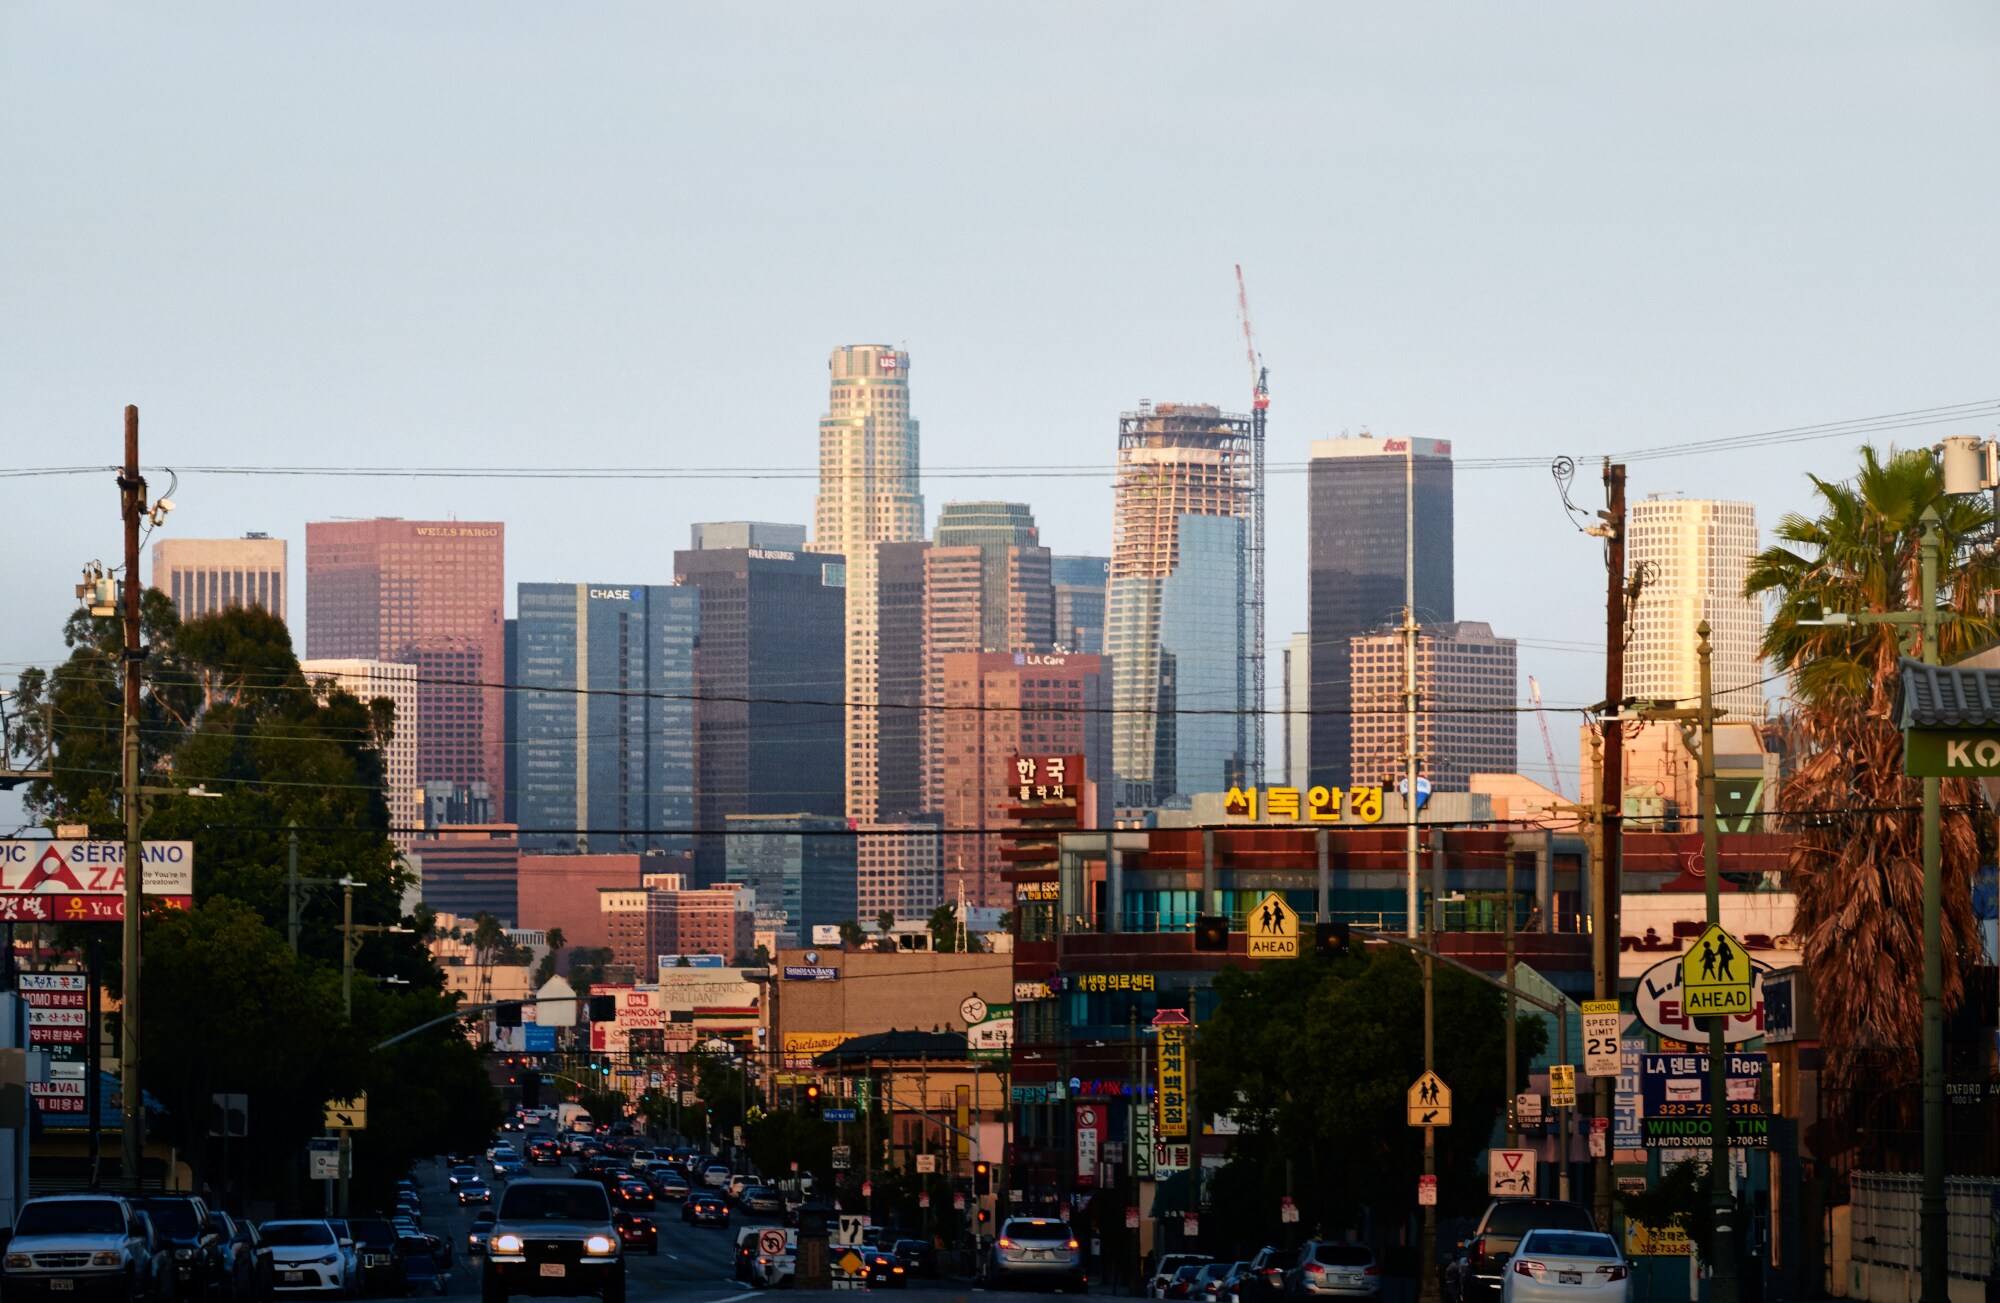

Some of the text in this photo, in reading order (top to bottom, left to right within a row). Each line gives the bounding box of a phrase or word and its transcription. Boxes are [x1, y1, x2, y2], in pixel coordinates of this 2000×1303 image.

[417, 527, 498, 537] WELLS FARGO
[748, 549, 795, 561] PAUL HASTINGS
[591, 589, 631, 600] CHASE
[1044, 655, 1065, 665] Care
[1947, 739, 2000, 768] KO
[1016, 758, 1065, 785] 한국
[1020, 785, 1064, 801] 플라자
[1224, 786, 1383, 822] 서독안경
[1017, 881, 1040, 891] HANMI
[65, 897, 88, 920] 유
[91, 902, 111, 916] Yu
[1253, 941, 1294, 952] AHEAD
[786, 967, 835, 976] SHINHAN BANK
[664, 982, 702, 993] COMIC
[1078, 975, 1155, 992] 새생명의료센터
[1690, 992, 1746, 1008] AHEAD
[1584, 1003, 1617, 1012] SCHOOL
[1586, 1018, 1616, 1027] SPEED
[1589, 1028, 1613, 1036] LIMIT
[1588, 1038, 1617, 1055] 25
[1646, 1058, 1666, 1074] LA
[1670, 1057, 1697, 1075] 덴트
[1081, 1079, 1122, 1097] RE/MAX
[1946, 1083, 1981, 1095] OXFORD
[50, 1098, 84, 1111] 미용실
[825, 1111, 854, 1119] Harvard
[1647, 1120, 1767, 1135] WINDO TIN
[1646, 1137, 1656, 1147] JJ
[1658, 1136, 1680, 1147] AUTO
[1682, 1136, 1713, 1147] SOUND
[1158, 1147, 1188, 1166] 이불
